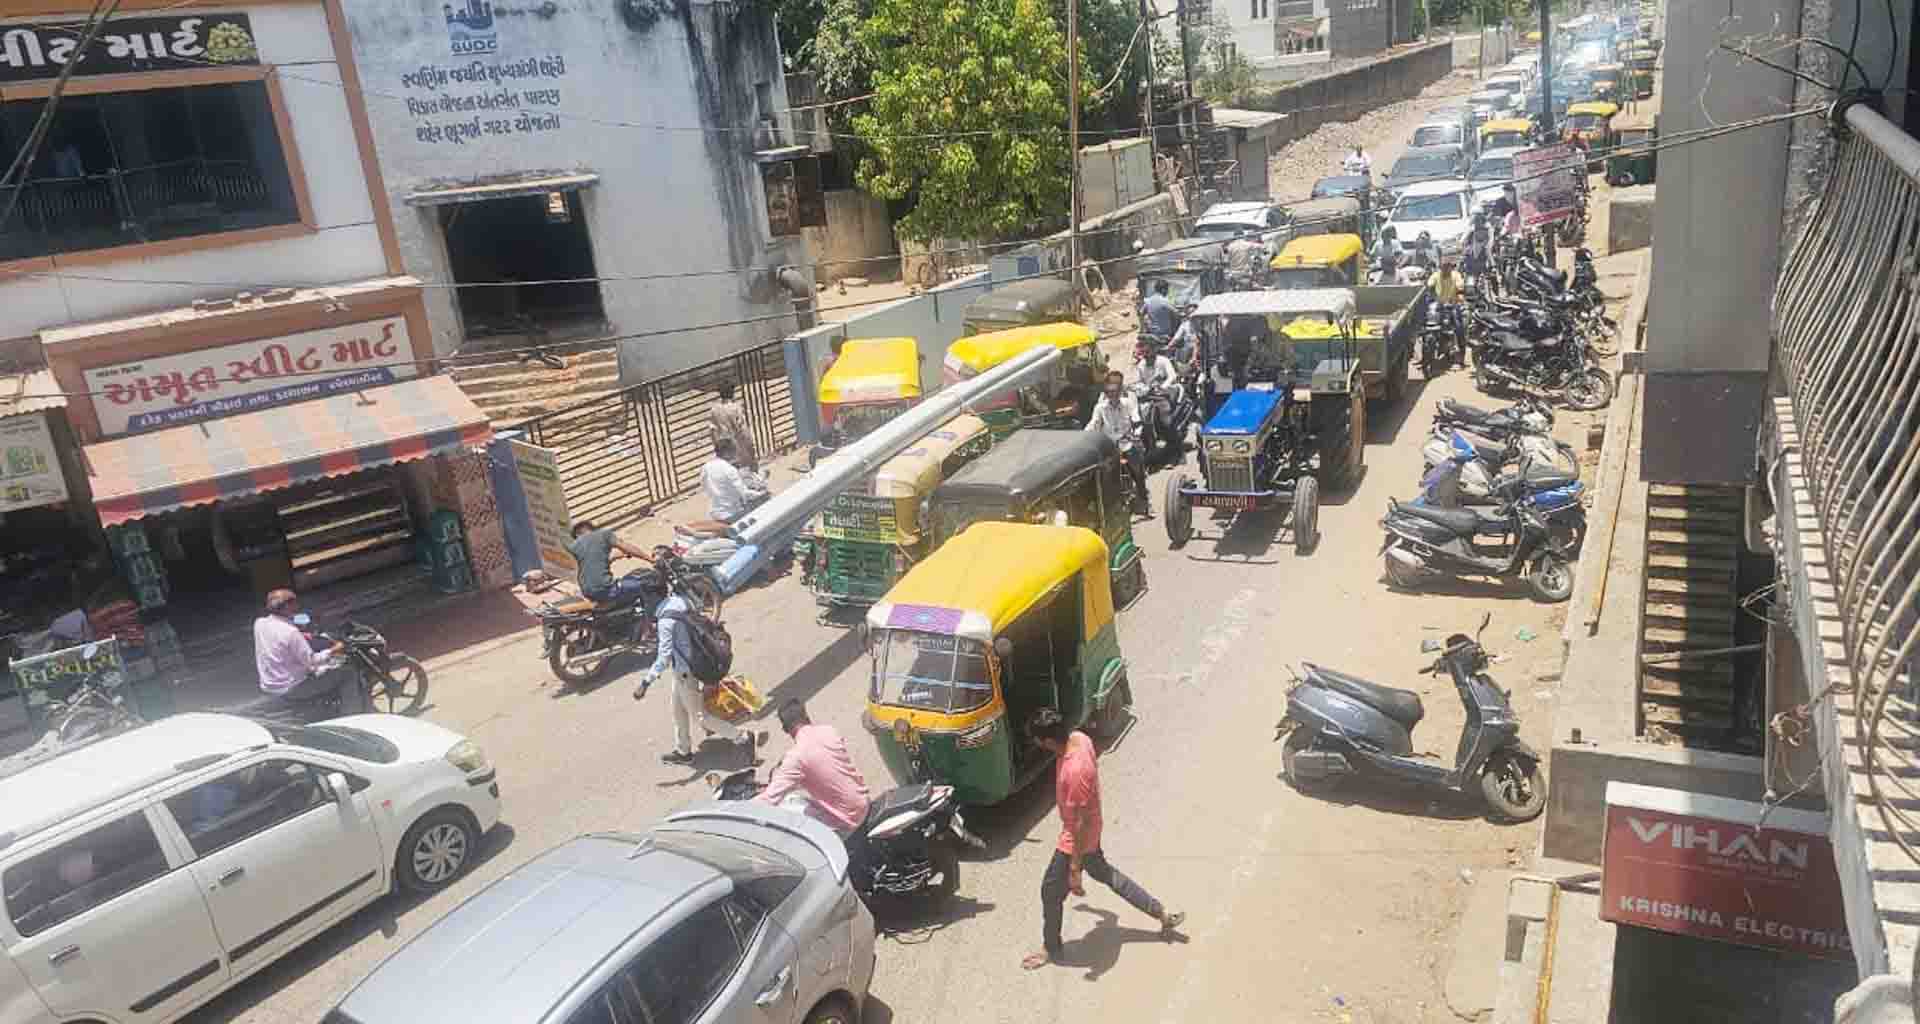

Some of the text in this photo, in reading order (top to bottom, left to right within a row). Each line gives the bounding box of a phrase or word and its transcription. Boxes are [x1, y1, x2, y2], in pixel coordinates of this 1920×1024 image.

[104, 18, 204, 60] માર્ટ
[102, 322, 398, 406] અમૃત સ્વીટ માર્ટ
[1625, 816, 1808, 868] VIHAN
[1620, 895, 1724, 929] KRISHNA
